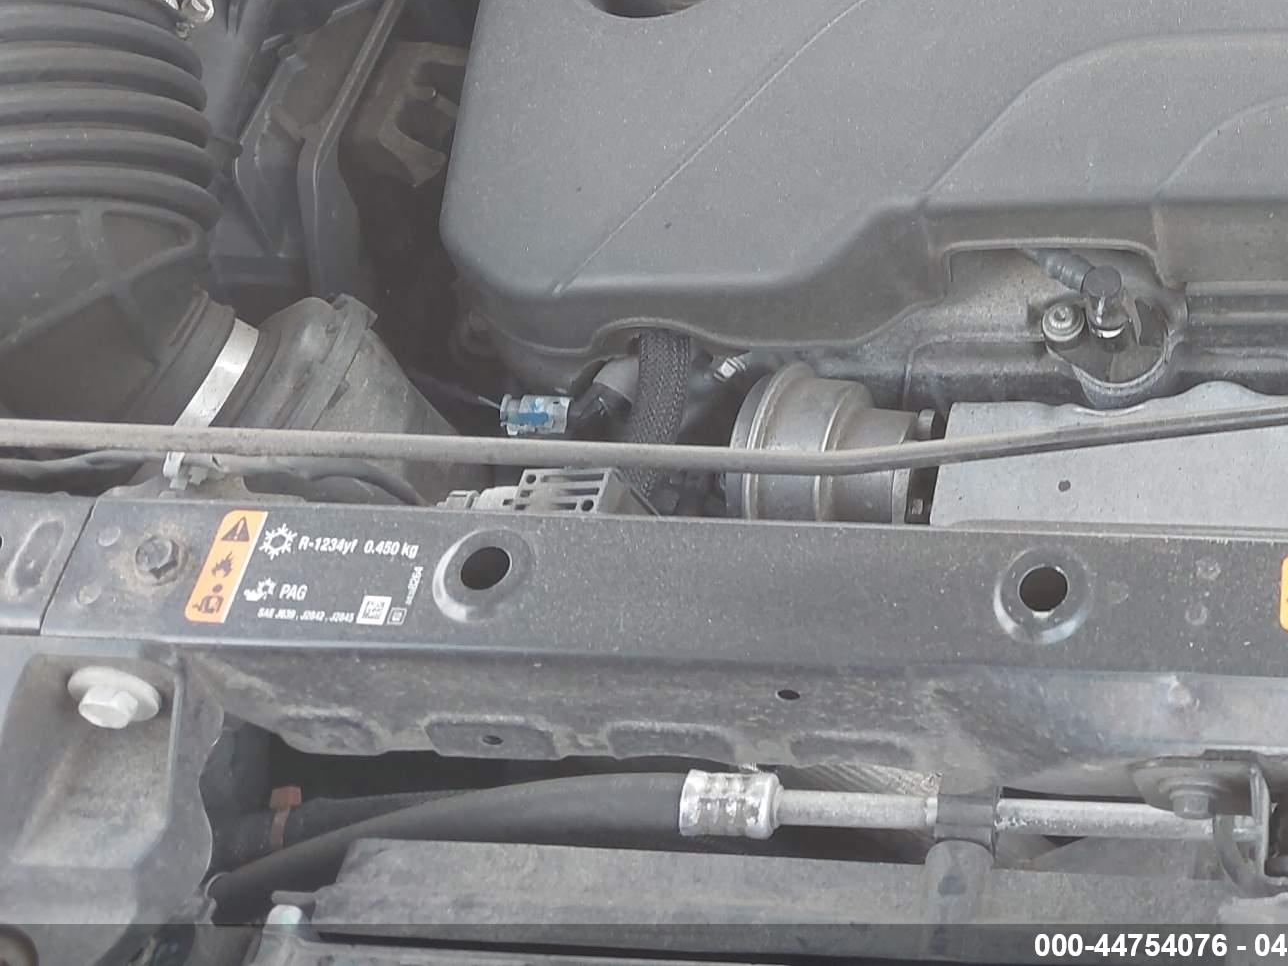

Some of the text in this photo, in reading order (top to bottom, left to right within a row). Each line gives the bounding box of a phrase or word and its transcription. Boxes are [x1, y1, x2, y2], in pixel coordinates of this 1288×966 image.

[298, 537, 419, 559] R-1234yf 0.450 kg
[278, 584, 308, 601] PAG
